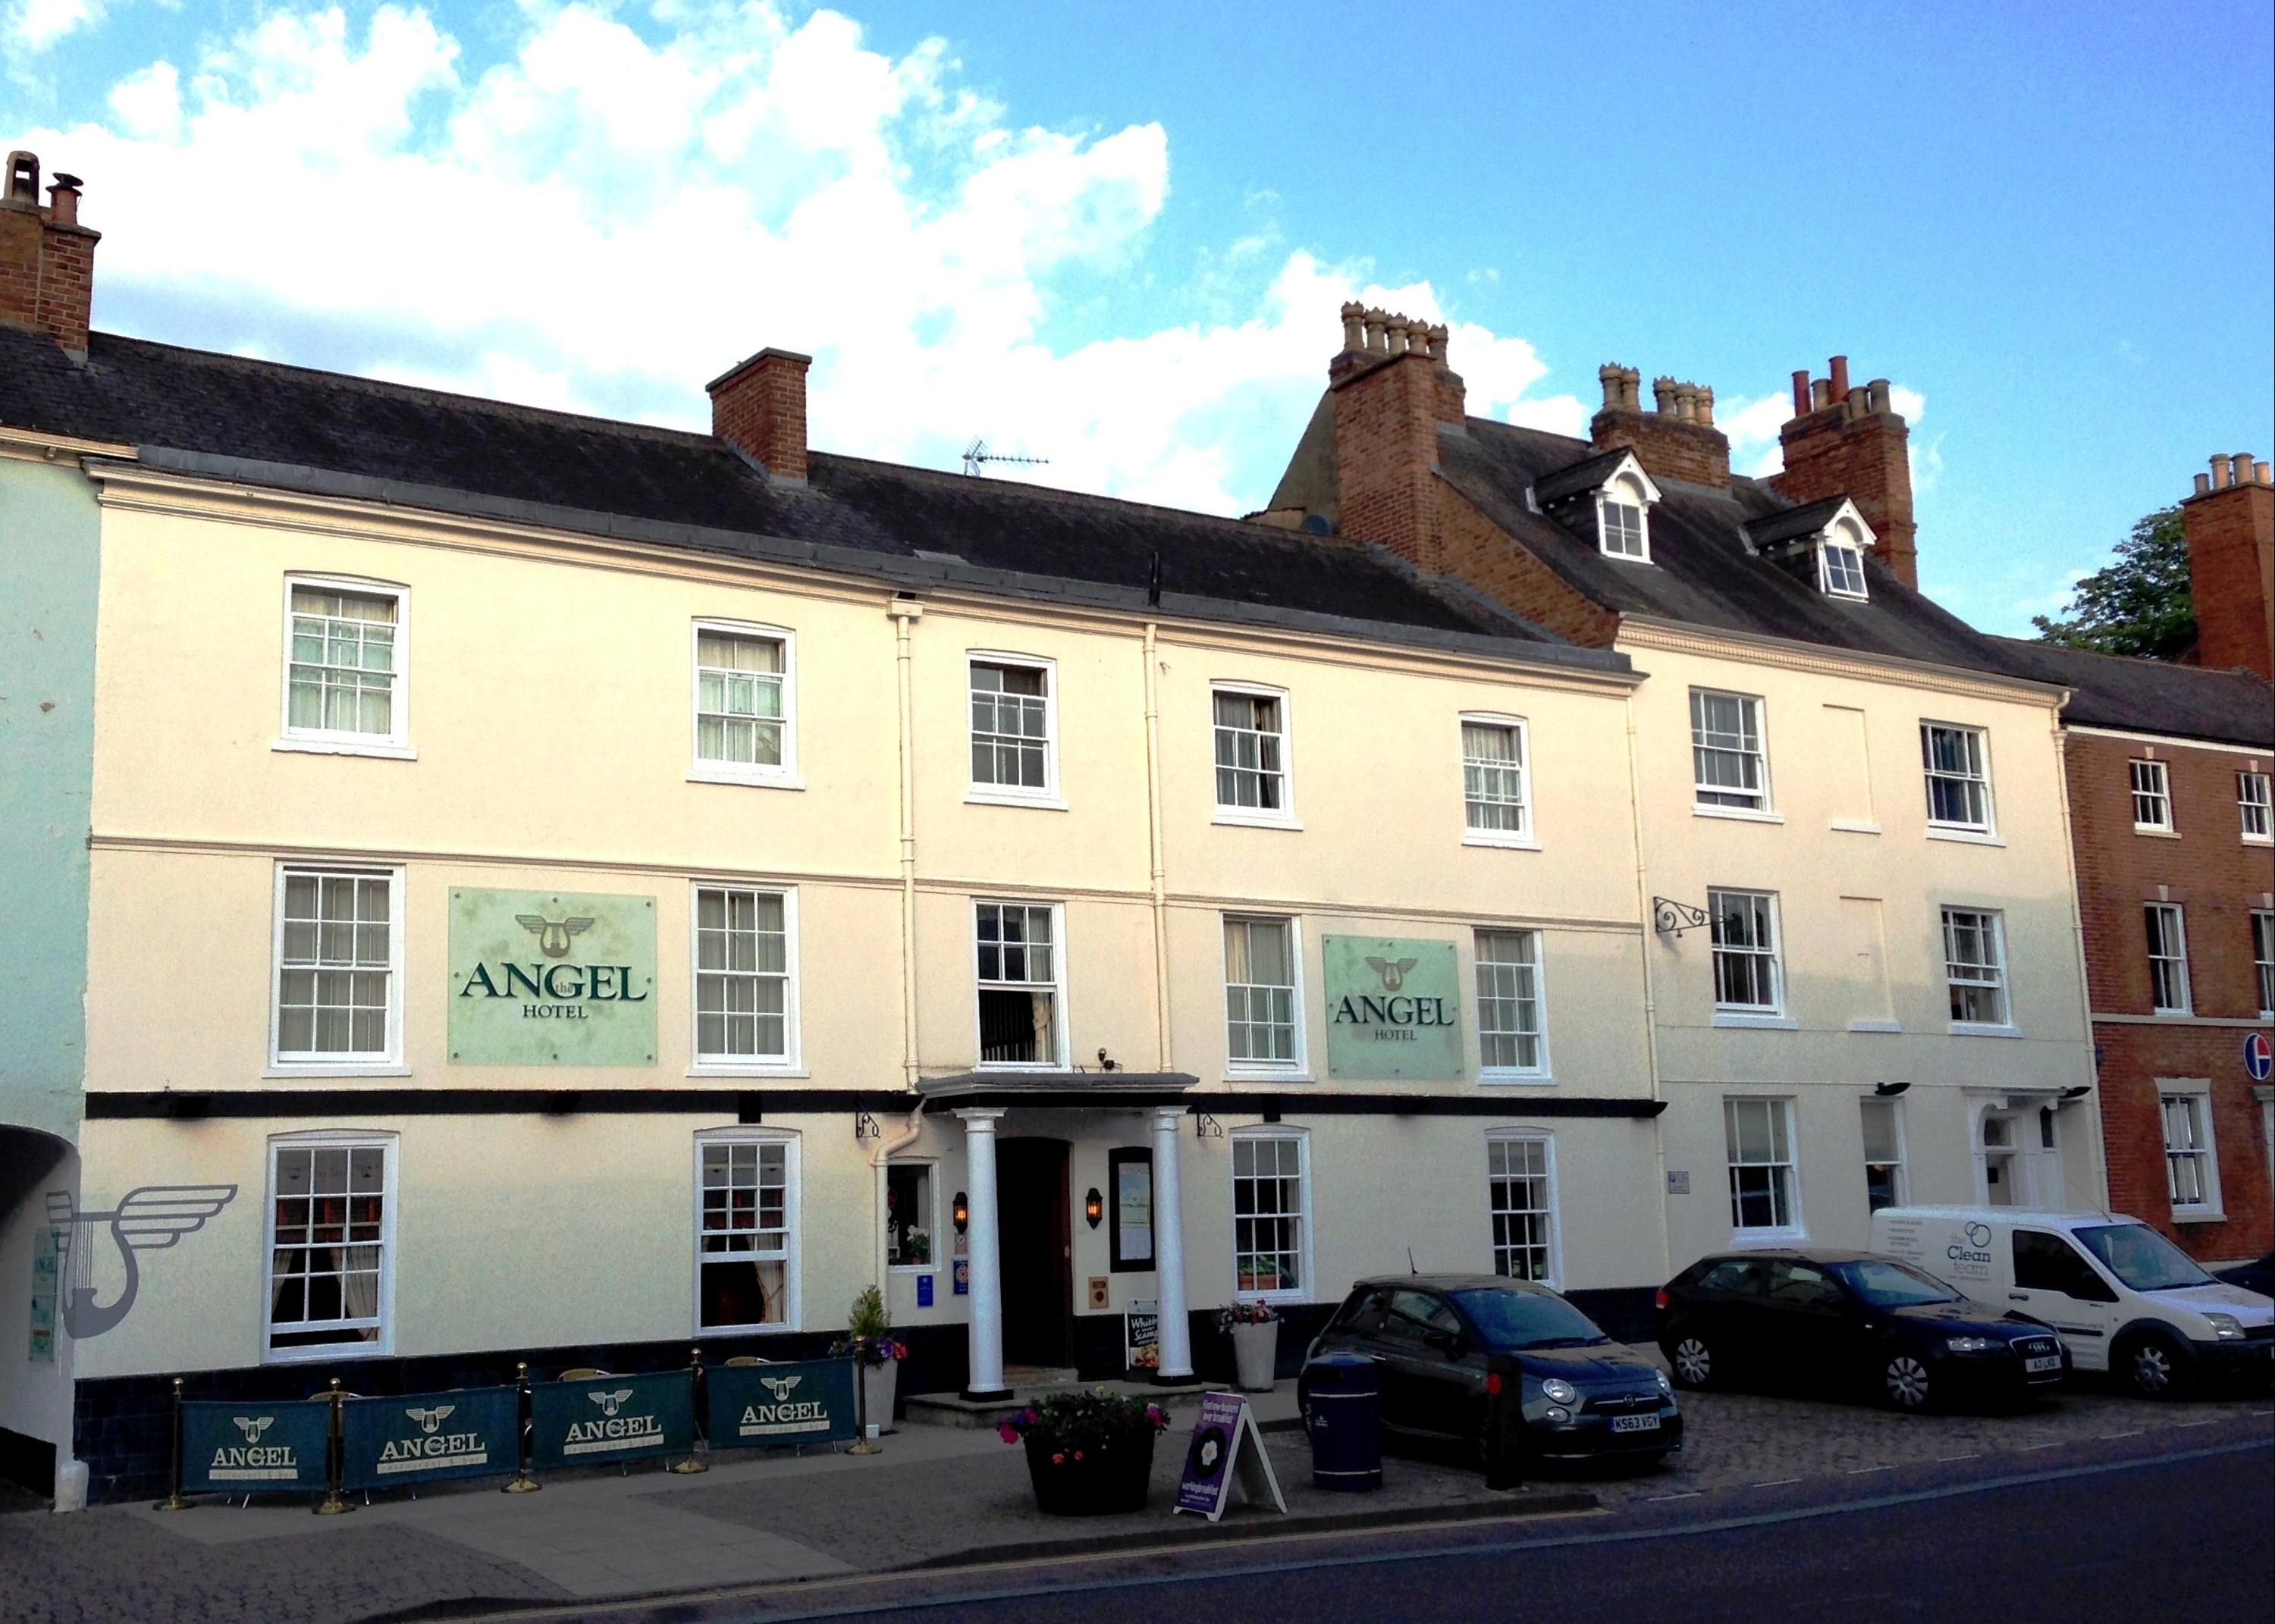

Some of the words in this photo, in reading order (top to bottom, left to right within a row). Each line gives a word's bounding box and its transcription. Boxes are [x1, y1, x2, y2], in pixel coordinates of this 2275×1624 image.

[459, 961, 648, 1002] ANGEL
[522, 1005, 588, 1019] HOTEL
[1335, 995, 1454, 1027] ANGEL
[1375, 1029, 1418, 1041] HOTEL
[1947, 1245, 1991, 1262] Clean
[1953, 1262, 1988, 1275] team
[740, 1401, 827, 1424] ANGEL
[565, 1416, 662, 1442] ANGEL
[1615, 1416, 1640, 1431] KS63
[211, 1447, 297, 1467] ANGEL
[378, 1432, 485, 1462] ANGEL
